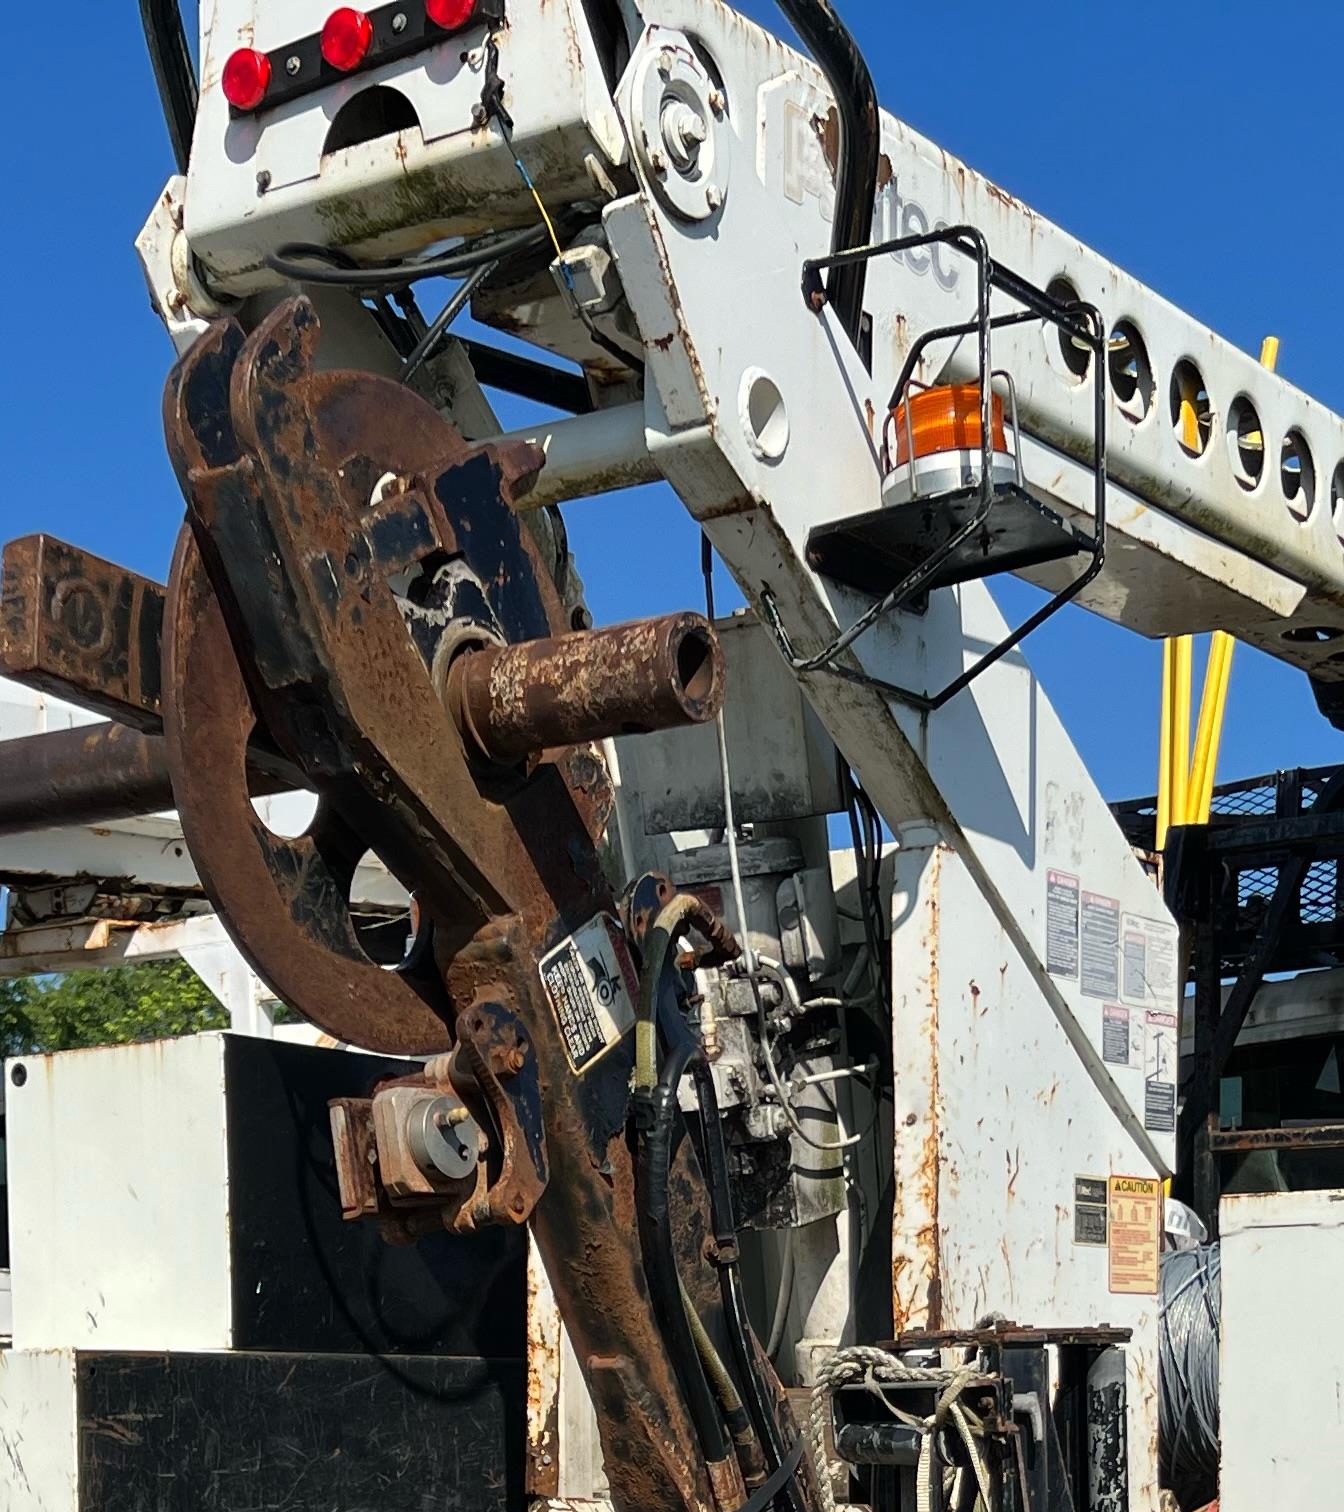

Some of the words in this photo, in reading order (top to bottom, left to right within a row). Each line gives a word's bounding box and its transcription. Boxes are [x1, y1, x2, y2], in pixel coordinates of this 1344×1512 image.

[544, 970, 569, 1026] CLOTHING
[562, 1024, 579, 1060] CLEAR
[559, 994, 578, 1034] HANDS
[572, 1032, 586, 1057] AND
[1121, 1180, 1154, 1194] CAUTION
